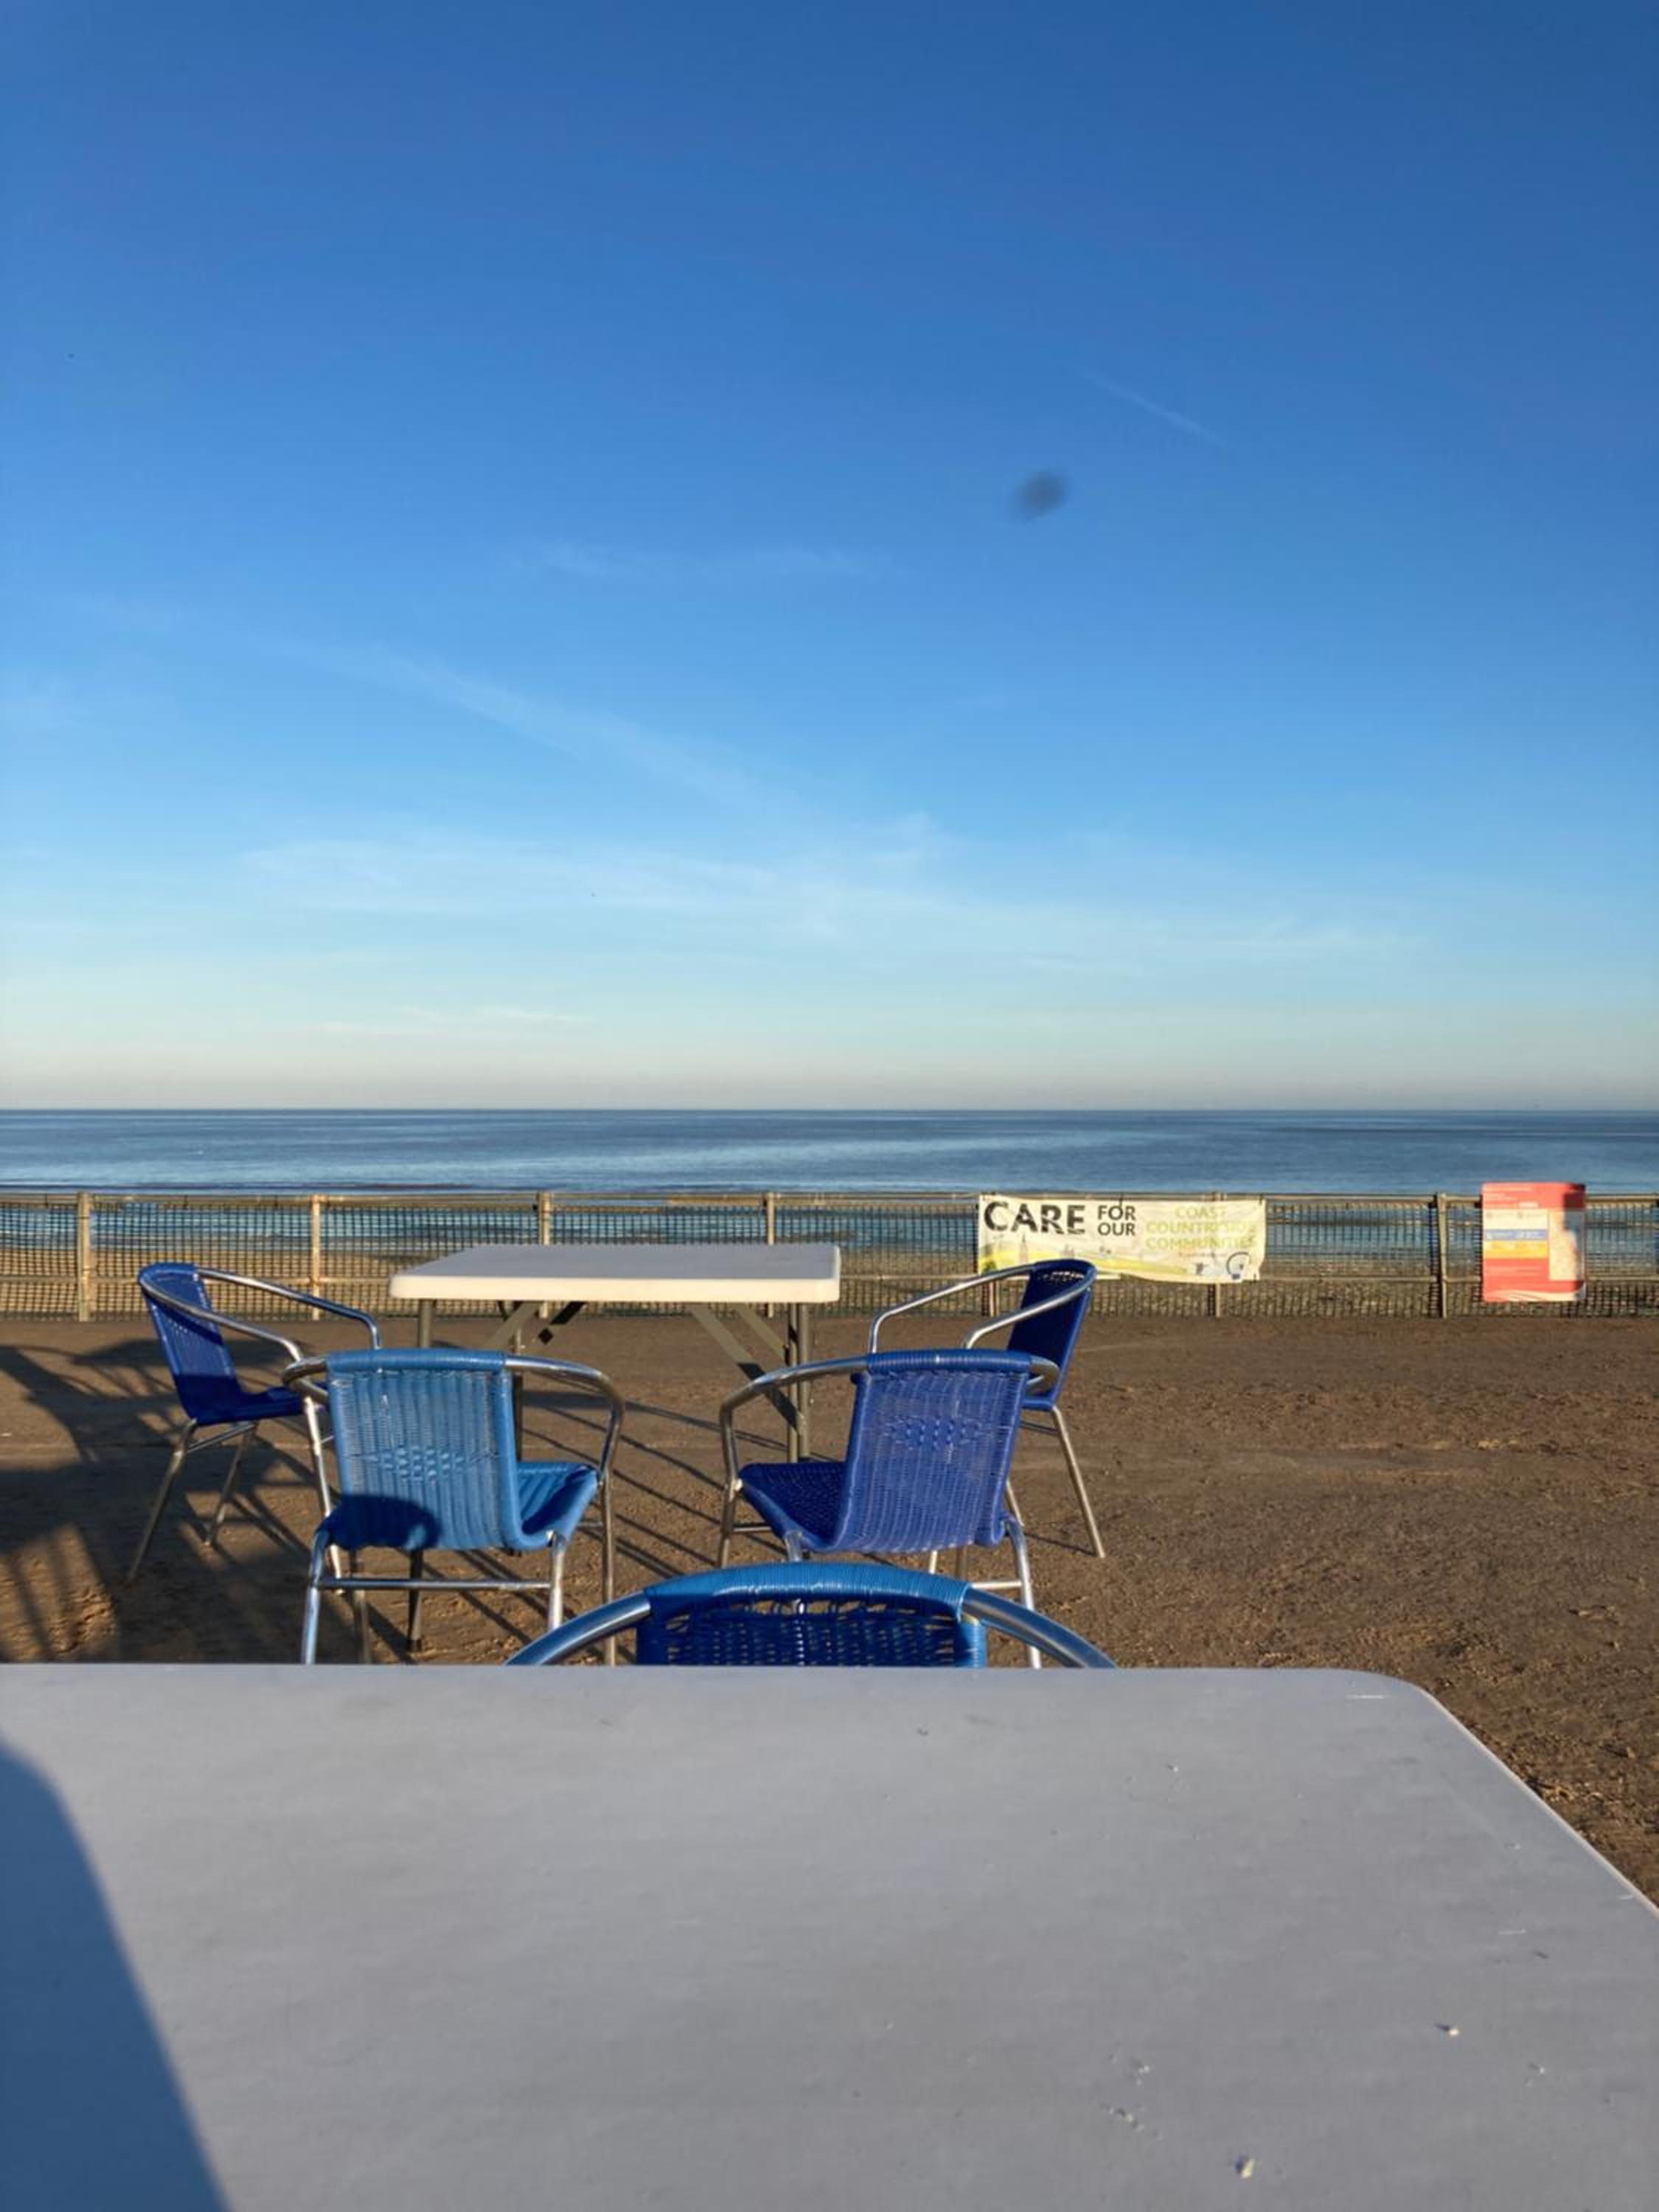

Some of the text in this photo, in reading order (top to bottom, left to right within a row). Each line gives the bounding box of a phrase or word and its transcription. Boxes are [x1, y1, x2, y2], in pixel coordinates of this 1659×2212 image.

[984, 1201, 1086, 1235] CARE
[1098, 1206, 1136, 1220] FOR
[1098, 1222, 1135, 1236] OUR
[1146, 1221, 1256, 1235] COUNTRID
